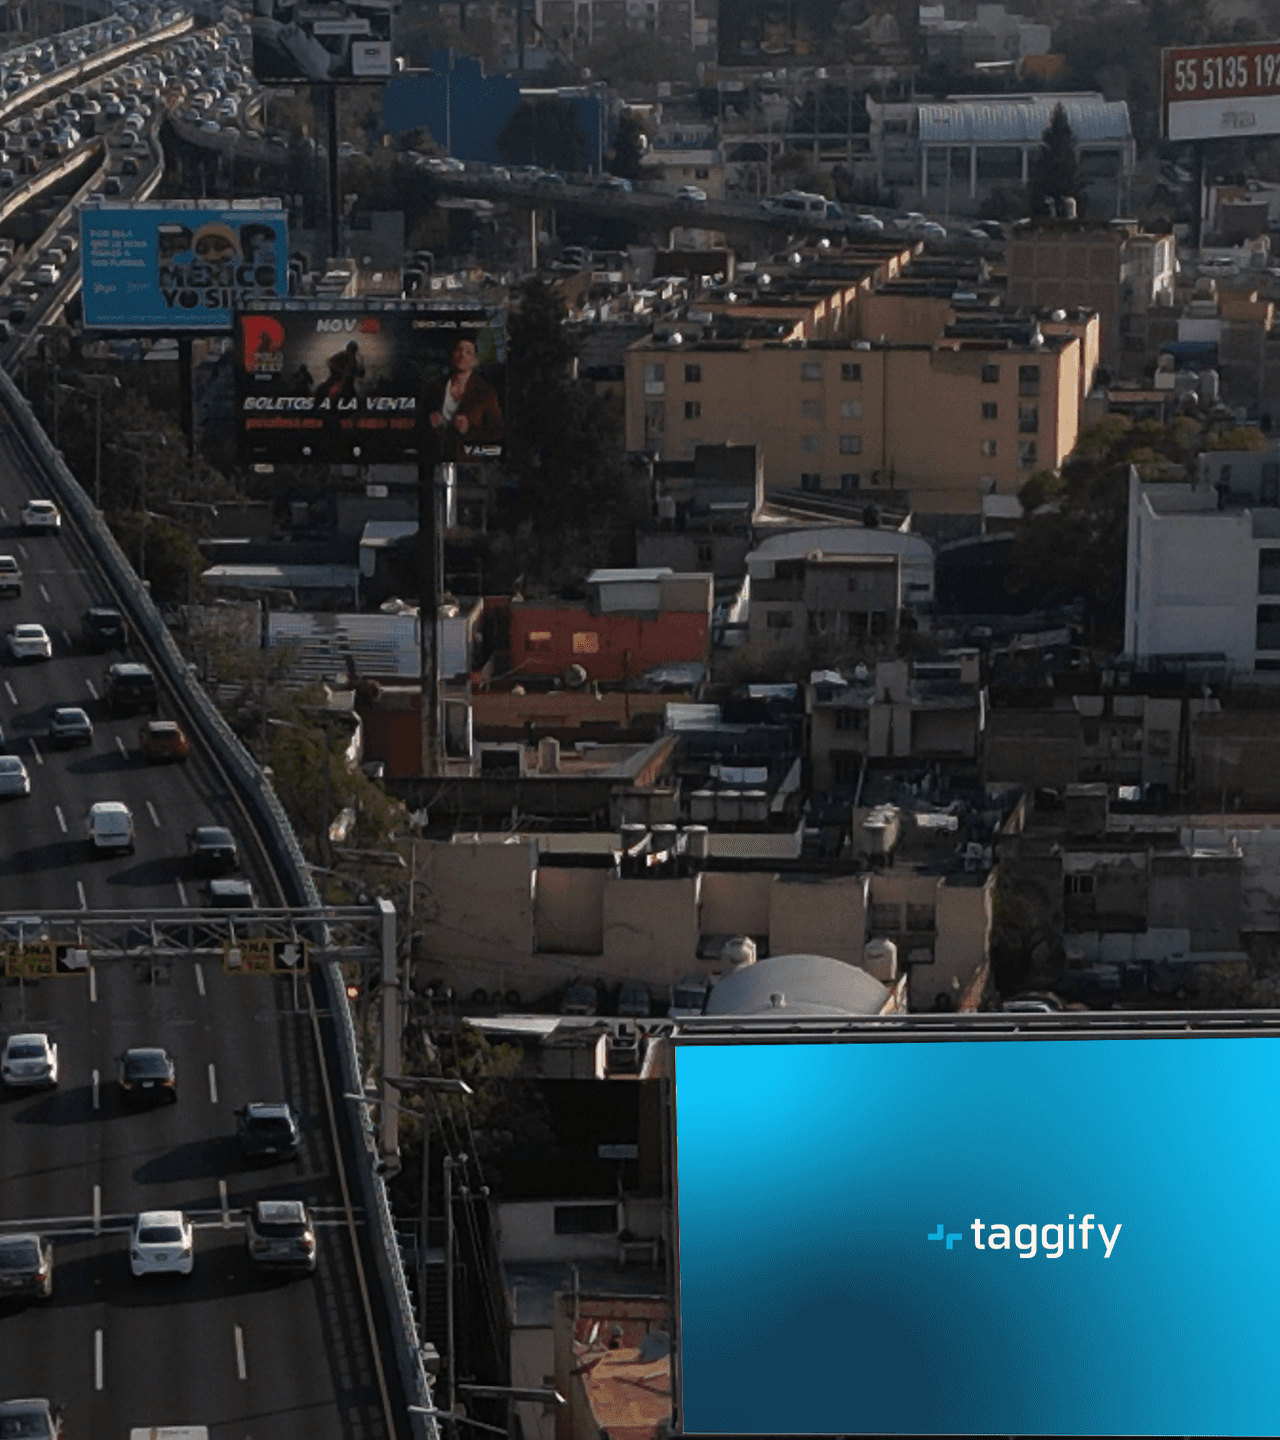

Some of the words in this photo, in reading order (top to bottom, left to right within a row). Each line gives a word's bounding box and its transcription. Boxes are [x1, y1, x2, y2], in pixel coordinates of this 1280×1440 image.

[1174, 58, 1198, 92] 55
[1202, 54, 1249, 90] 5135
[242, 396, 316, 411] BOLETOS
[318, 397, 332, 411] A
[336, 397, 359, 411] LA
[365, 396, 417, 411] VENTA
[970, 1214, 1123, 1258] taggify
